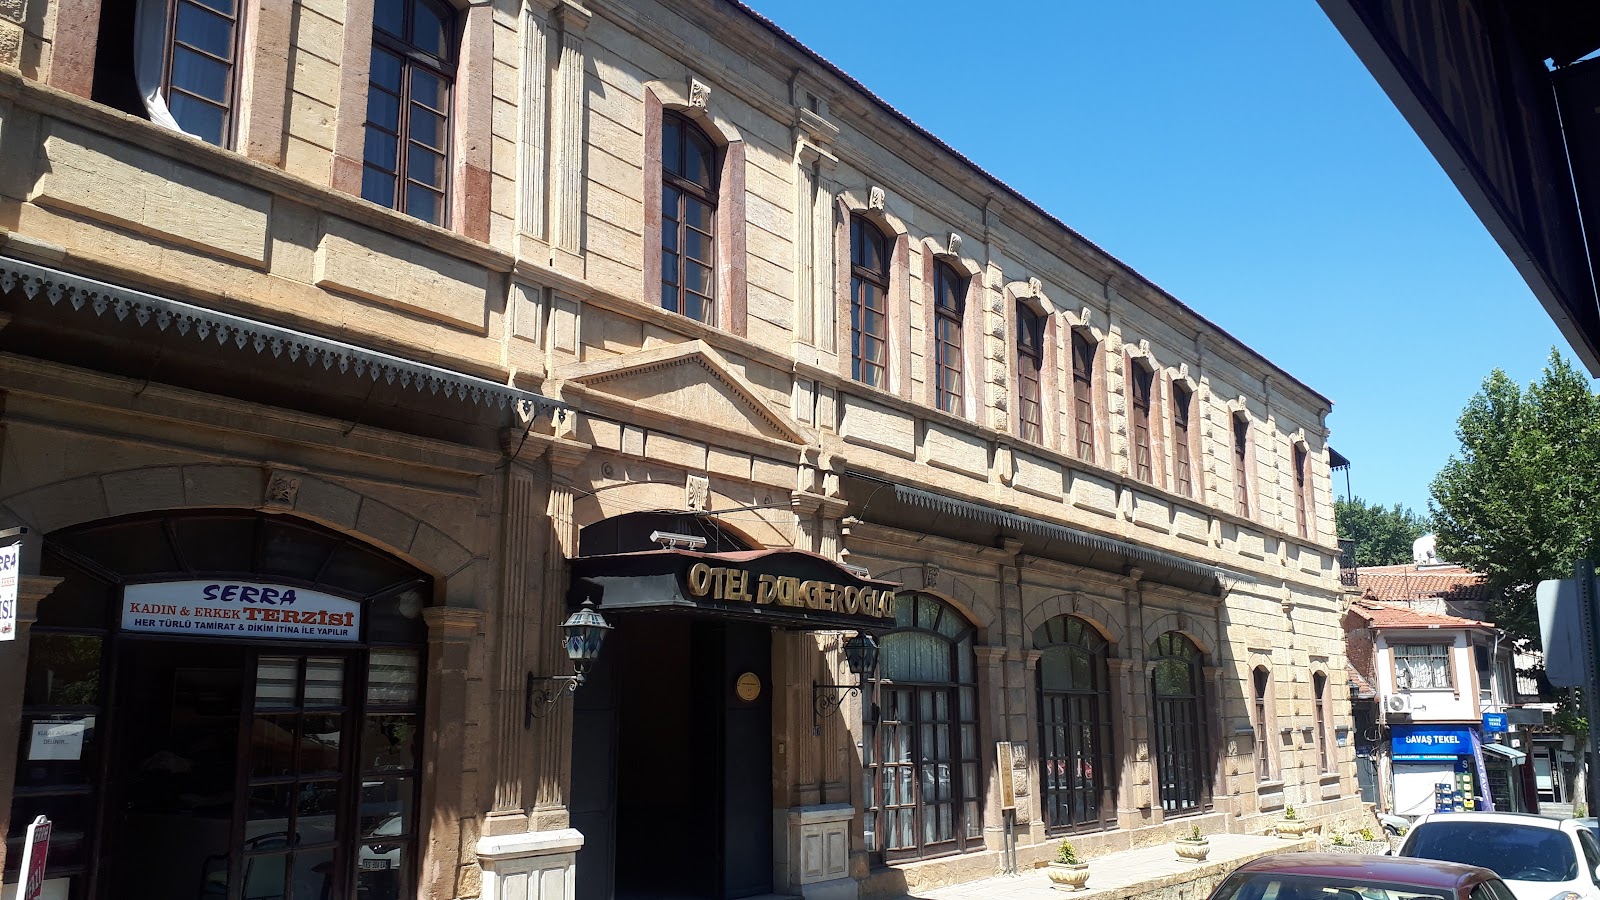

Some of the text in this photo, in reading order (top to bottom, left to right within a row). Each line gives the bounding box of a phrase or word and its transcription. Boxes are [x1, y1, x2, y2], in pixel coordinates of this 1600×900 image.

[687, 562, 752, 601] OTEL
[203, 584, 297, 605] SERRA
[129, 602, 355, 627] KADIN & ERKEK TERZİSİ
[134, 618, 156, 627] HER
[159, 618, 191, 629] TÜRLÜ
[195, 620, 236, 631] TAMİRAT
[238, 623, 245, 631] &
[248, 623, 274, 633] DİKİM
[316, 627, 348, 636] YAPILIR
[1405, 735, 1433, 746] SAVAŞ
[1433, 735, 1460, 744] TEKEL
